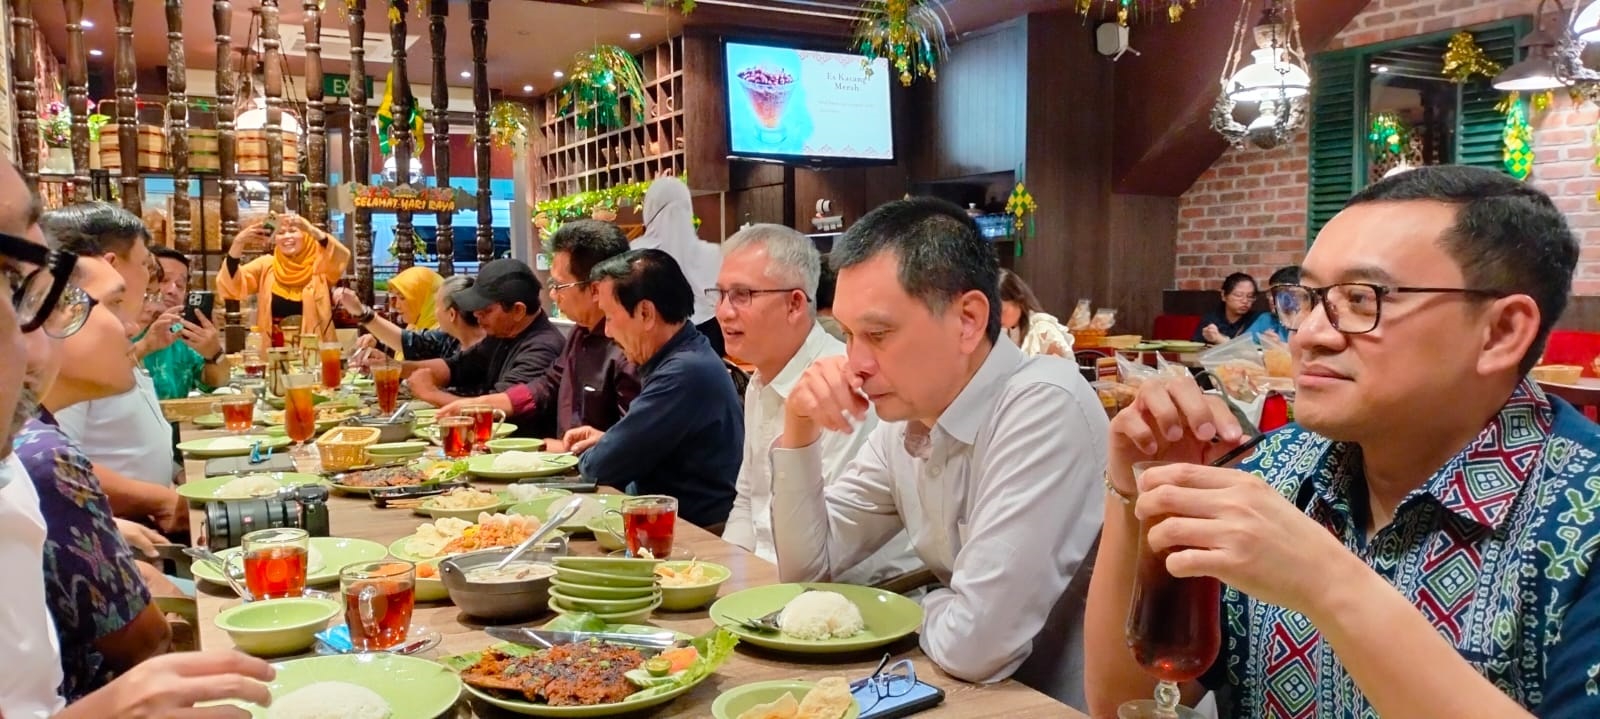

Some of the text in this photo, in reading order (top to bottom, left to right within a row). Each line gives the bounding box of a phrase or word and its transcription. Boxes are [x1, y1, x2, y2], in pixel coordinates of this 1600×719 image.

[333, 79, 350, 94] EX
[354, 196, 398, 209] SELAMAT
[429, 199, 455, 212] RAYA
